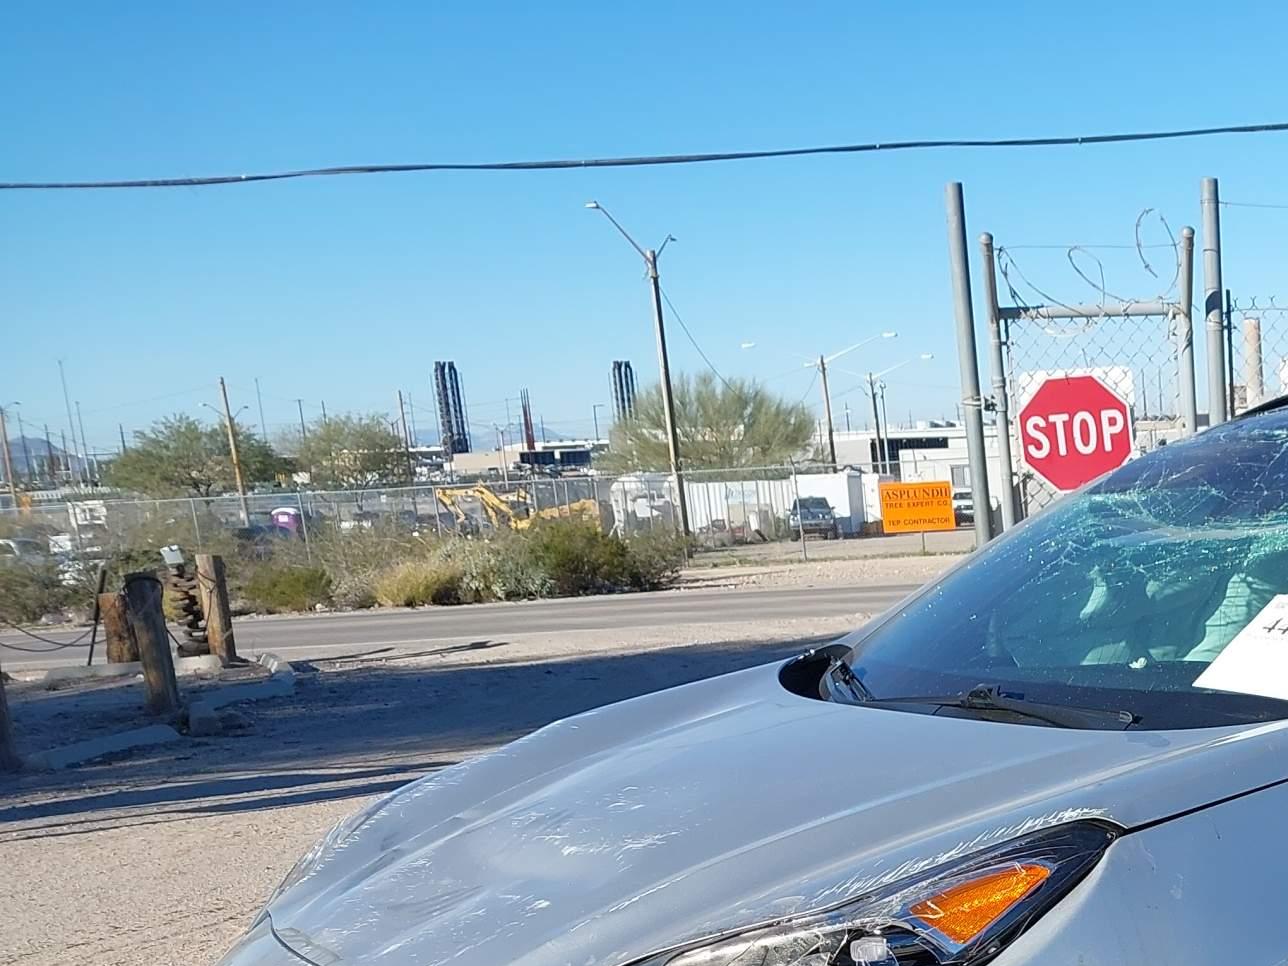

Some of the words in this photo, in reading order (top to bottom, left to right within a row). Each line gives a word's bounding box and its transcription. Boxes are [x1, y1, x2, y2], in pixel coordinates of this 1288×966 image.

[1026, 408, 1124, 459] STOP
[886, 488, 948, 499] ASPLUNDH
[903, 516, 950, 526] CONTRACTOR
